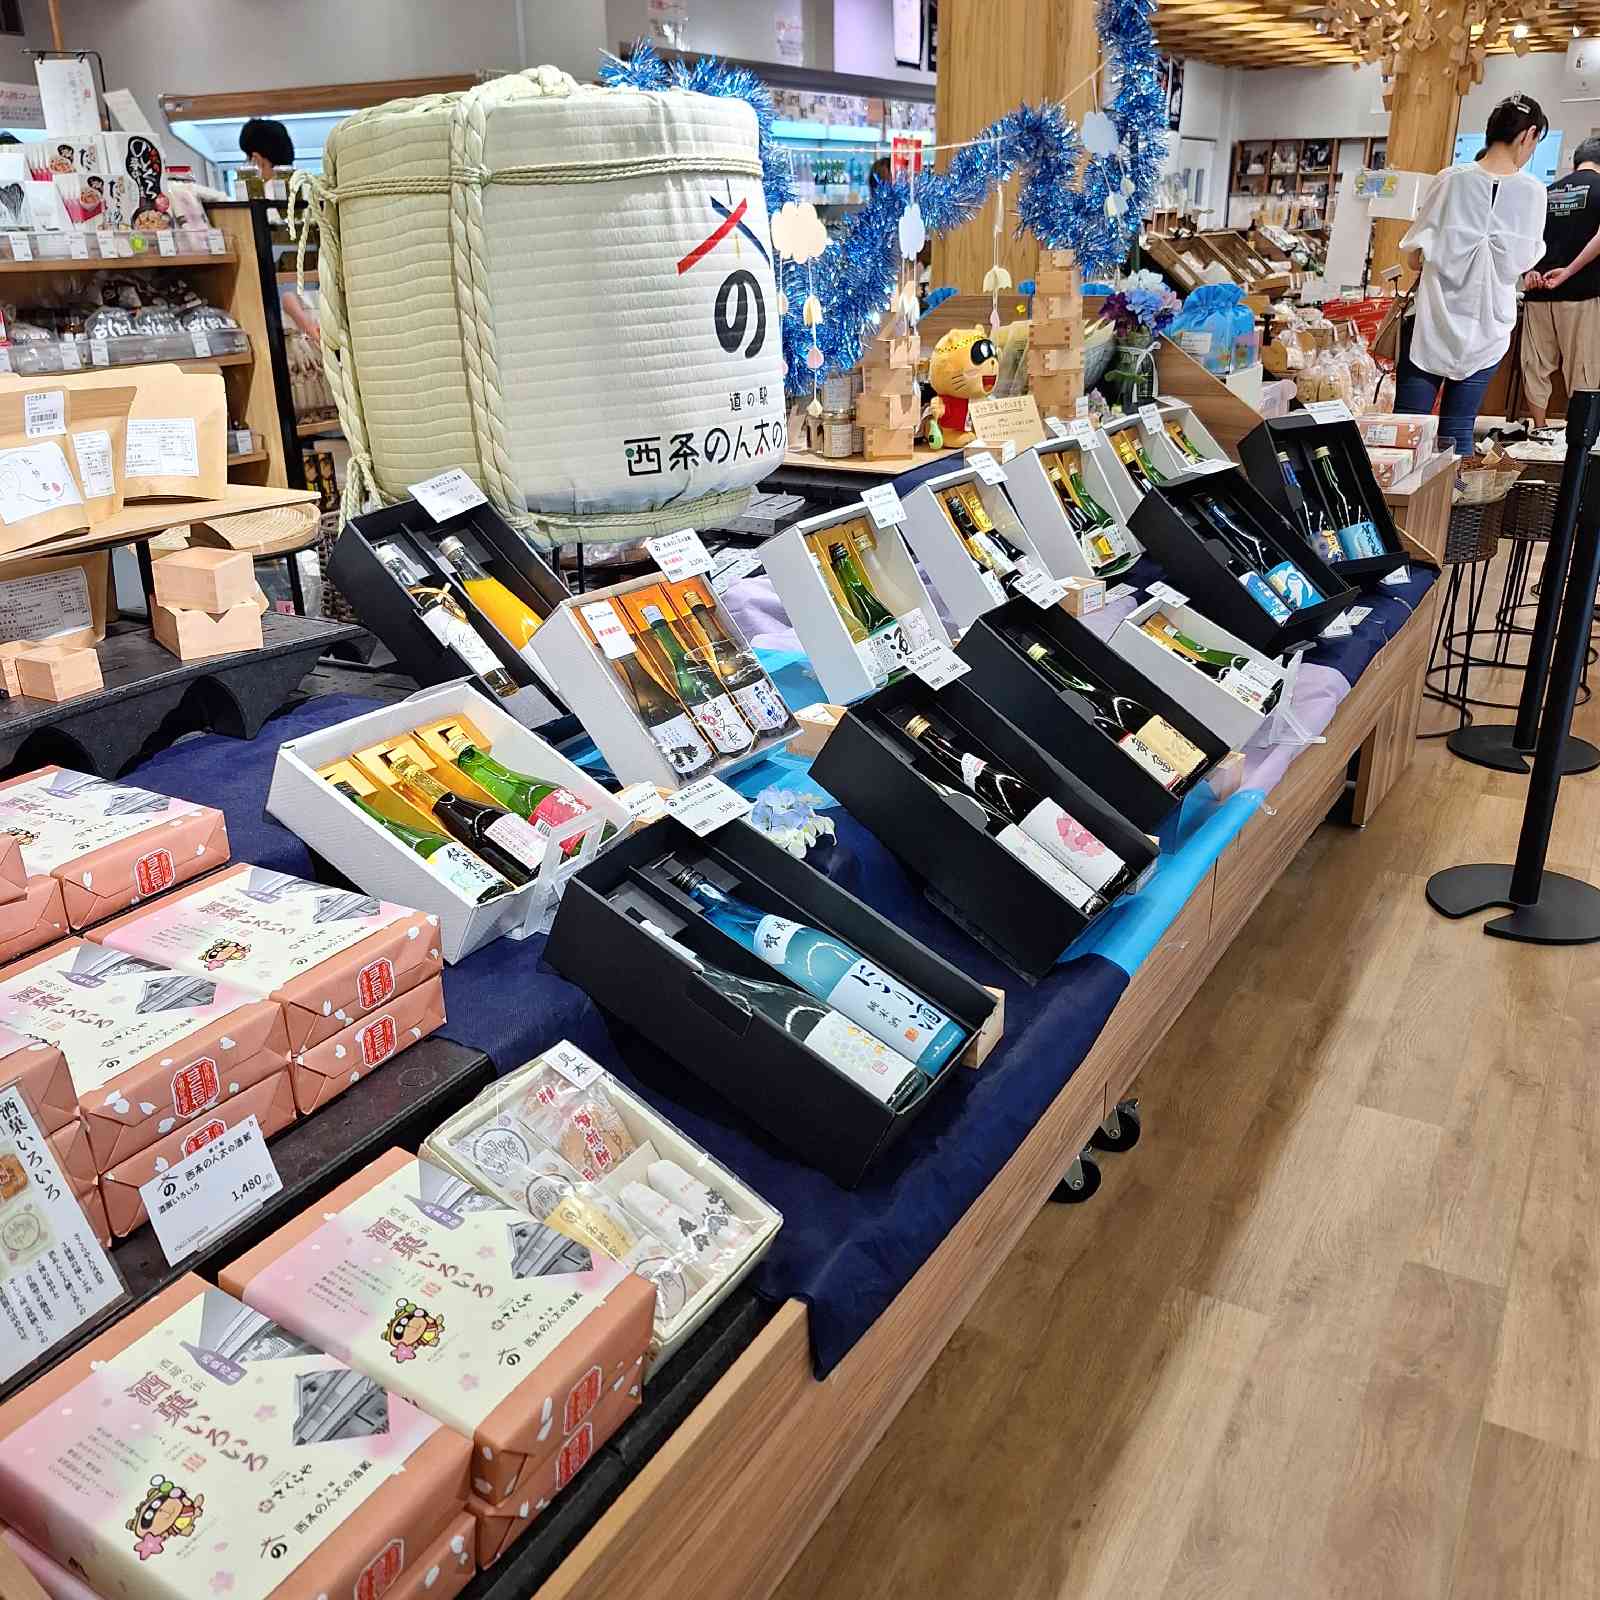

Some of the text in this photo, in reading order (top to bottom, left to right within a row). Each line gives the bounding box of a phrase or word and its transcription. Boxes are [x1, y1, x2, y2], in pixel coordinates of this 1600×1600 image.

[729, 385, 768, 412] 道の駅
[556, 1051, 592, 1078] 見本
[231, 1175, 262, 1202] 1,480
